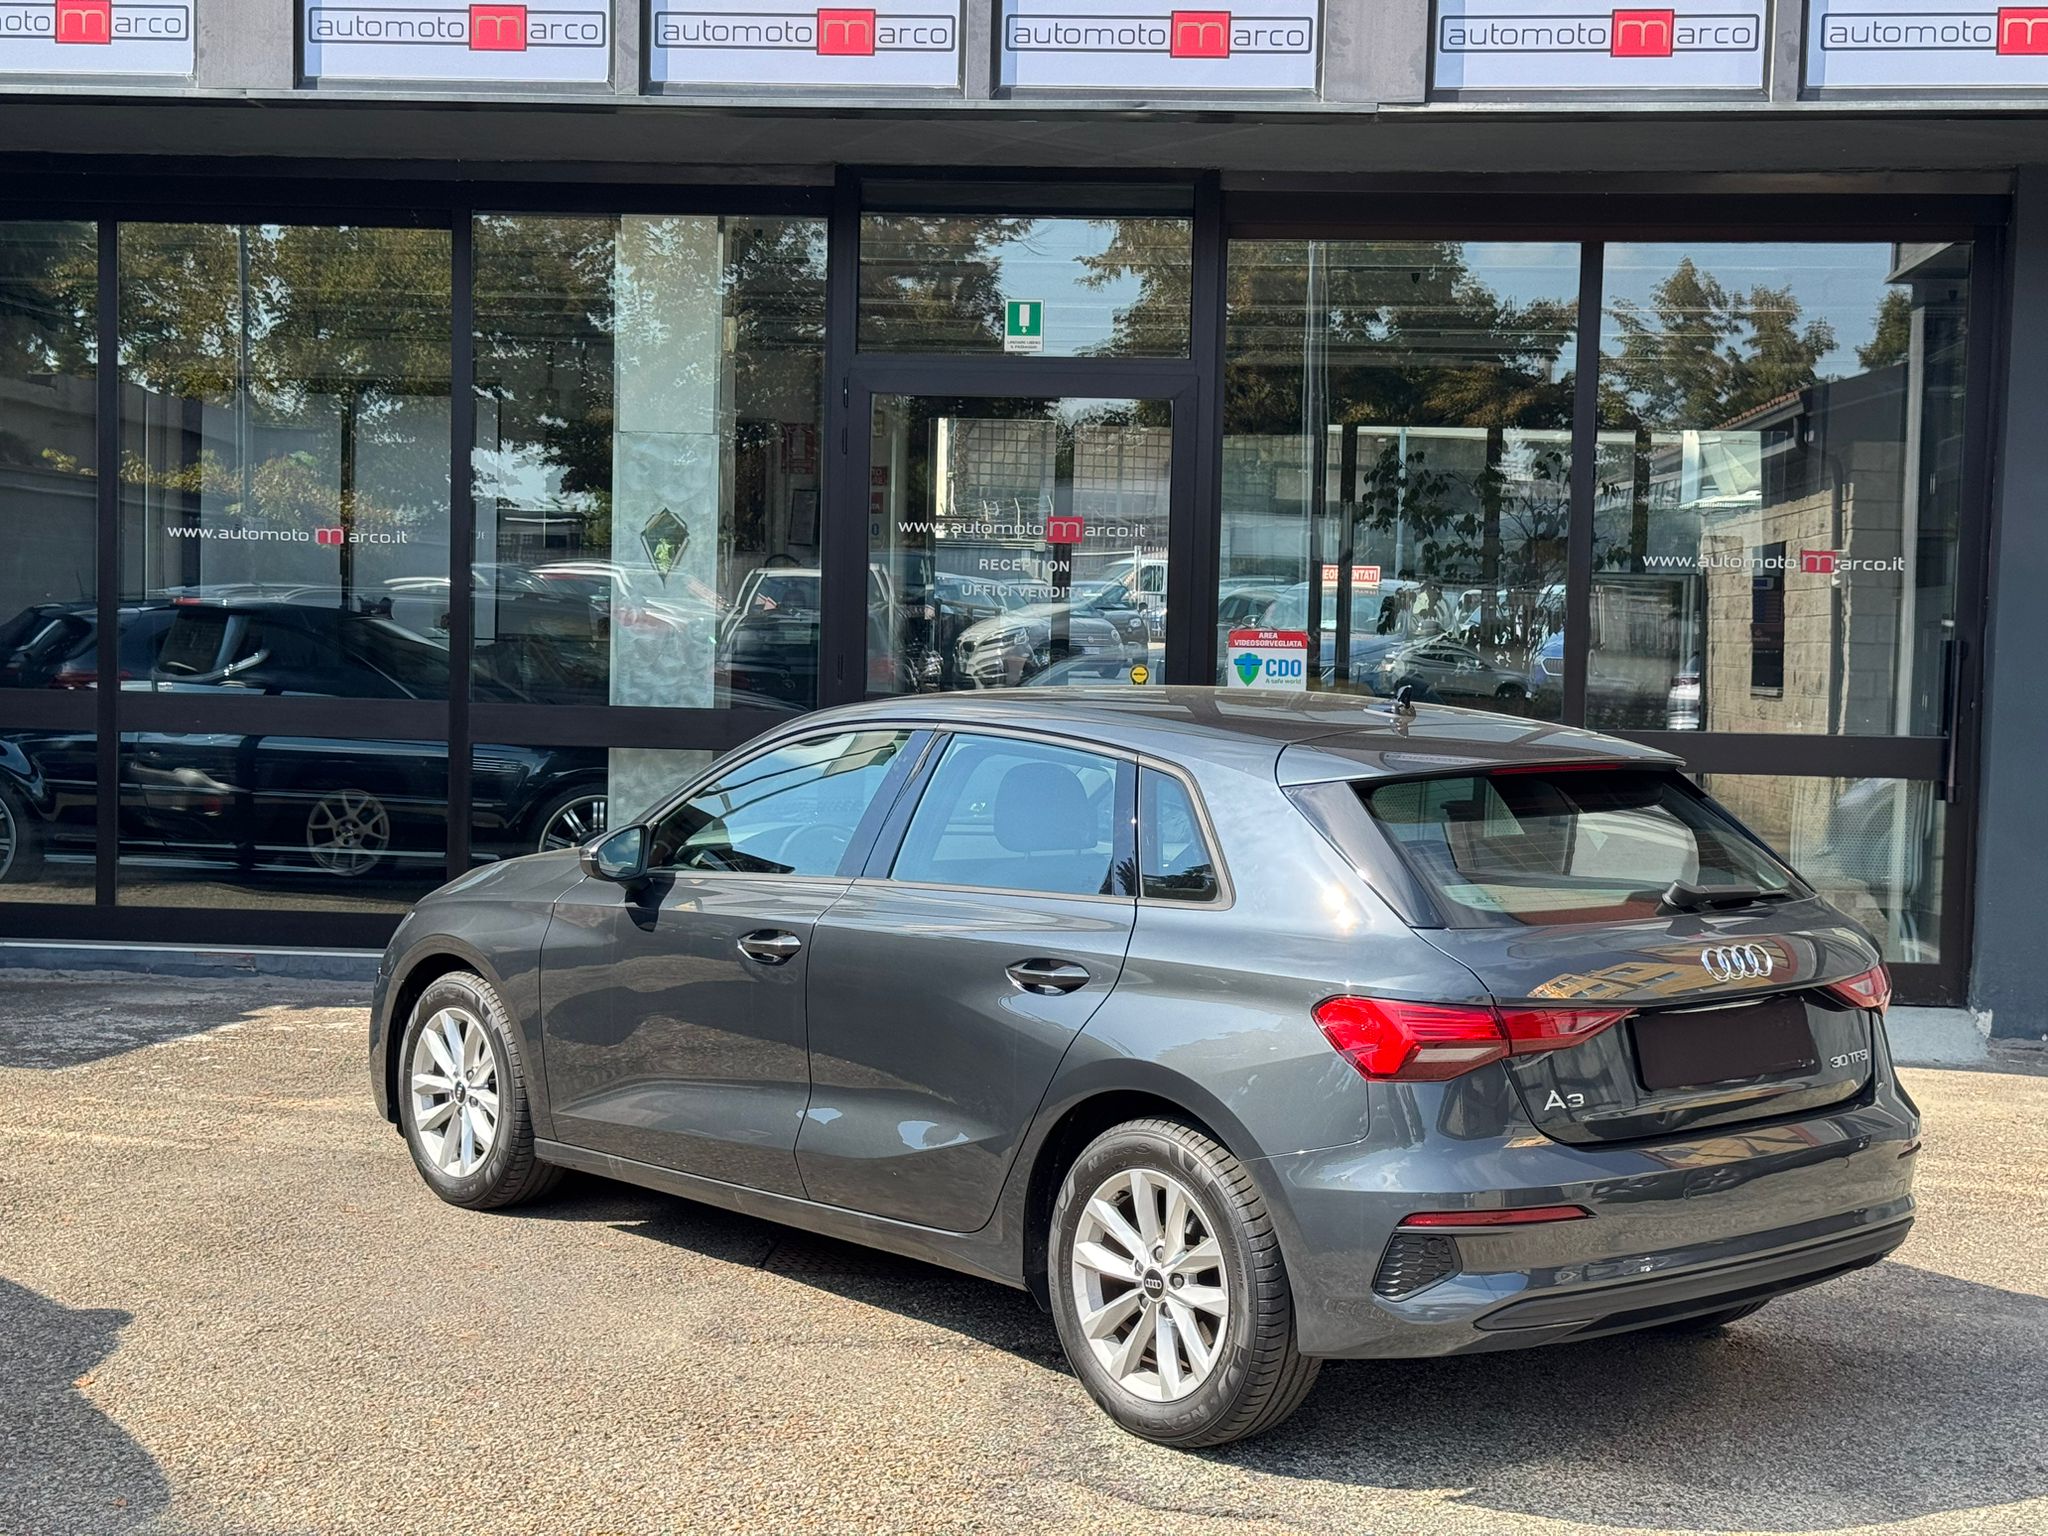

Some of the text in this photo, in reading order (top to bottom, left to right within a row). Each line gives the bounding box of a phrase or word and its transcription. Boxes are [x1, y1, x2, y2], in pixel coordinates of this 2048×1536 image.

[978, 559, 1070, 573] RECEPTION
[961, 584, 1085, 599] UFFICI VENDITA
[1233, 639, 1303, 648] VIDEOSORVEGLIATA
[1265, 658, 1302, 677] CDO
[1829, 1054, 1848, 1068] 30
[1543, 1089, 1585, 1111] A3
